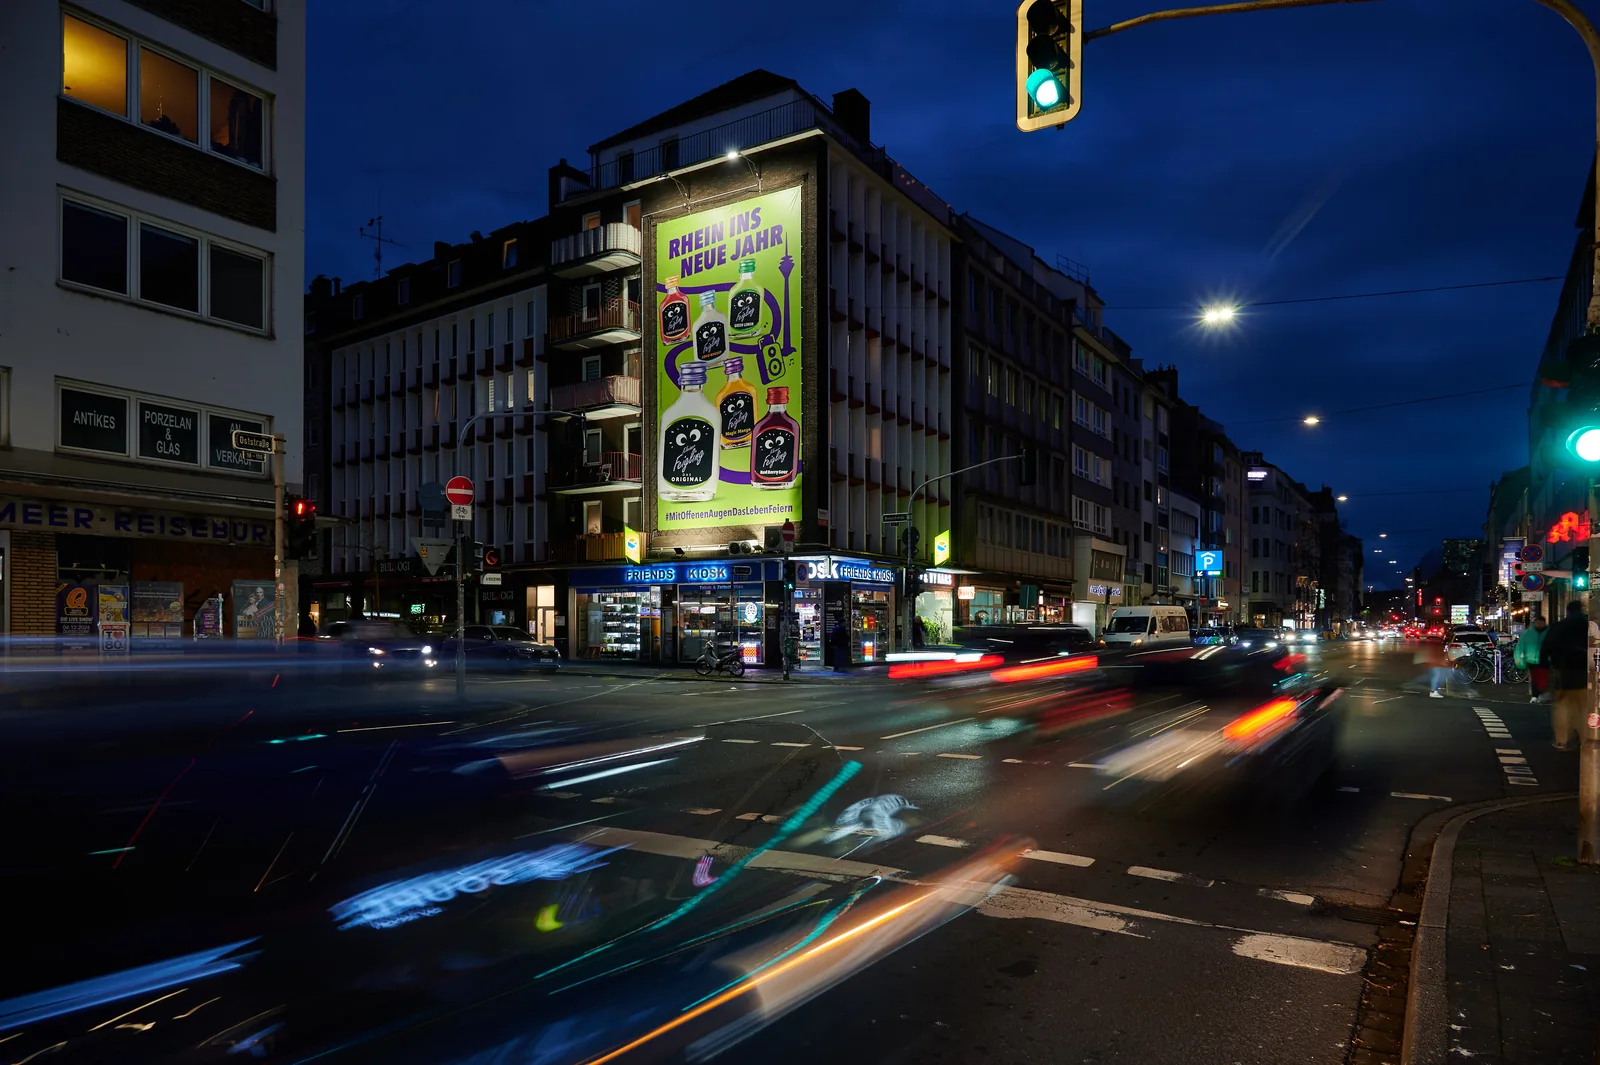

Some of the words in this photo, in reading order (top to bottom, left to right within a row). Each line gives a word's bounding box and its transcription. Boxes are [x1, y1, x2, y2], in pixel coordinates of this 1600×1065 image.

[669, 221, 724, 260] RHEIN
[730, 207, 761, 237] INS
[681, 244, 726, 278] NEUE
[730, 224, 783, 261] JAHR
[144, 410, 192, 430] PORZELAN
[165, 428, 172, 441] &
[239, 436, 270, 448] Oststraße
[156, 440, 181, 456] GLAS
[665, 504, 793, 520] #MitOffenenAugenDasLebenFeiern
[626, 569, 674, 580] FRIENDS
[688, 568, 726, 578] KIOSK
[842, 566, 872, 580] FRIENDS
[876, 570, 894, 582] KIOSK
